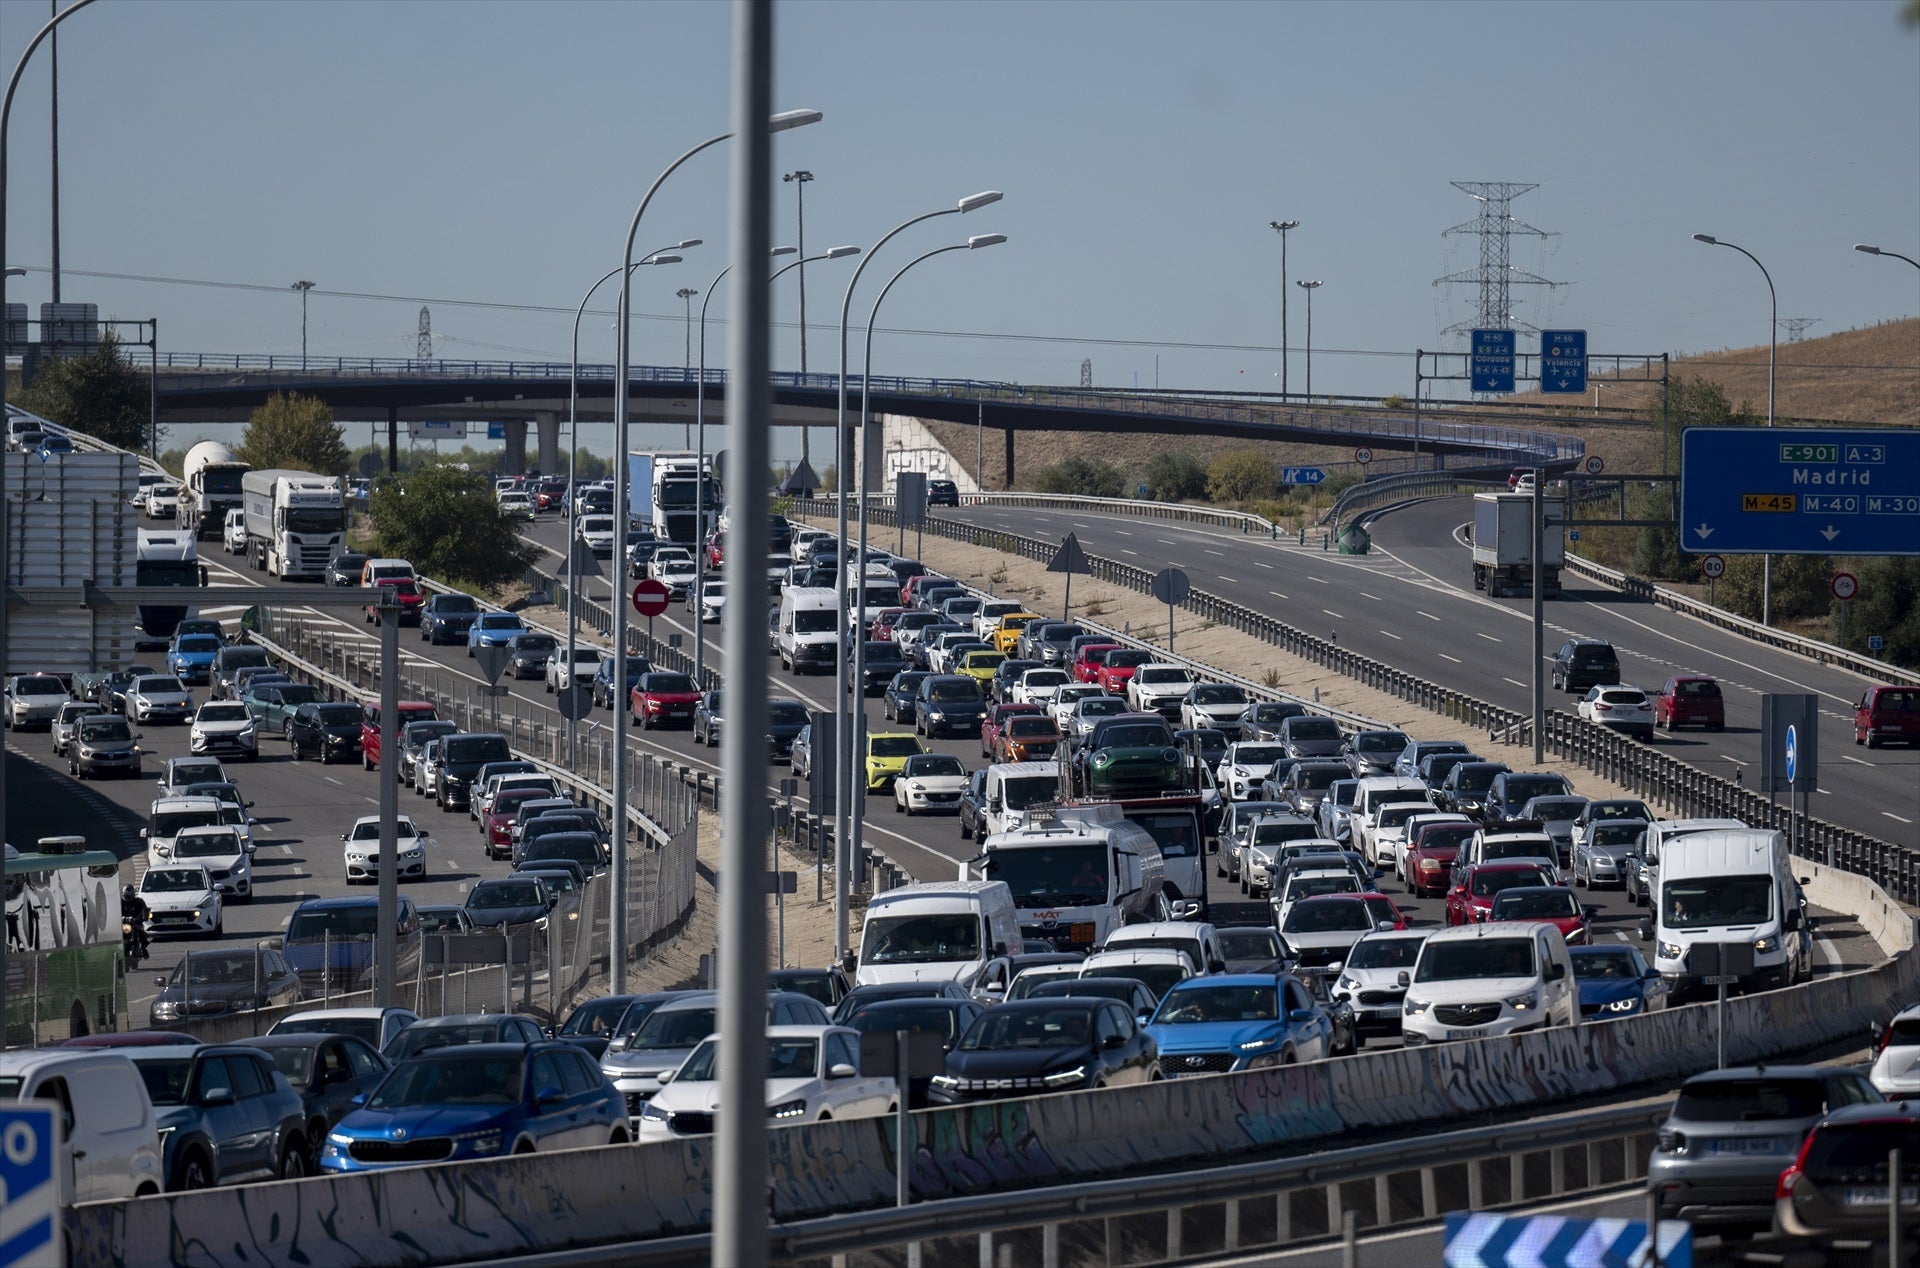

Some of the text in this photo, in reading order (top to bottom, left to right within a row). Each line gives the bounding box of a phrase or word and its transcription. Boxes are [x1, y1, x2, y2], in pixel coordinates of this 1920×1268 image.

[1358, 451, 1370, 459] 60
[1782, 446, 1882, 461] E-901 A-3
[1305, 472, 1318, 481] 14
[1792, 468, 1871, 485] Madrid
[1745, 497, 1918, 512] M-45 M-40 M-30
[1706, 562, 1721, 572] 80
